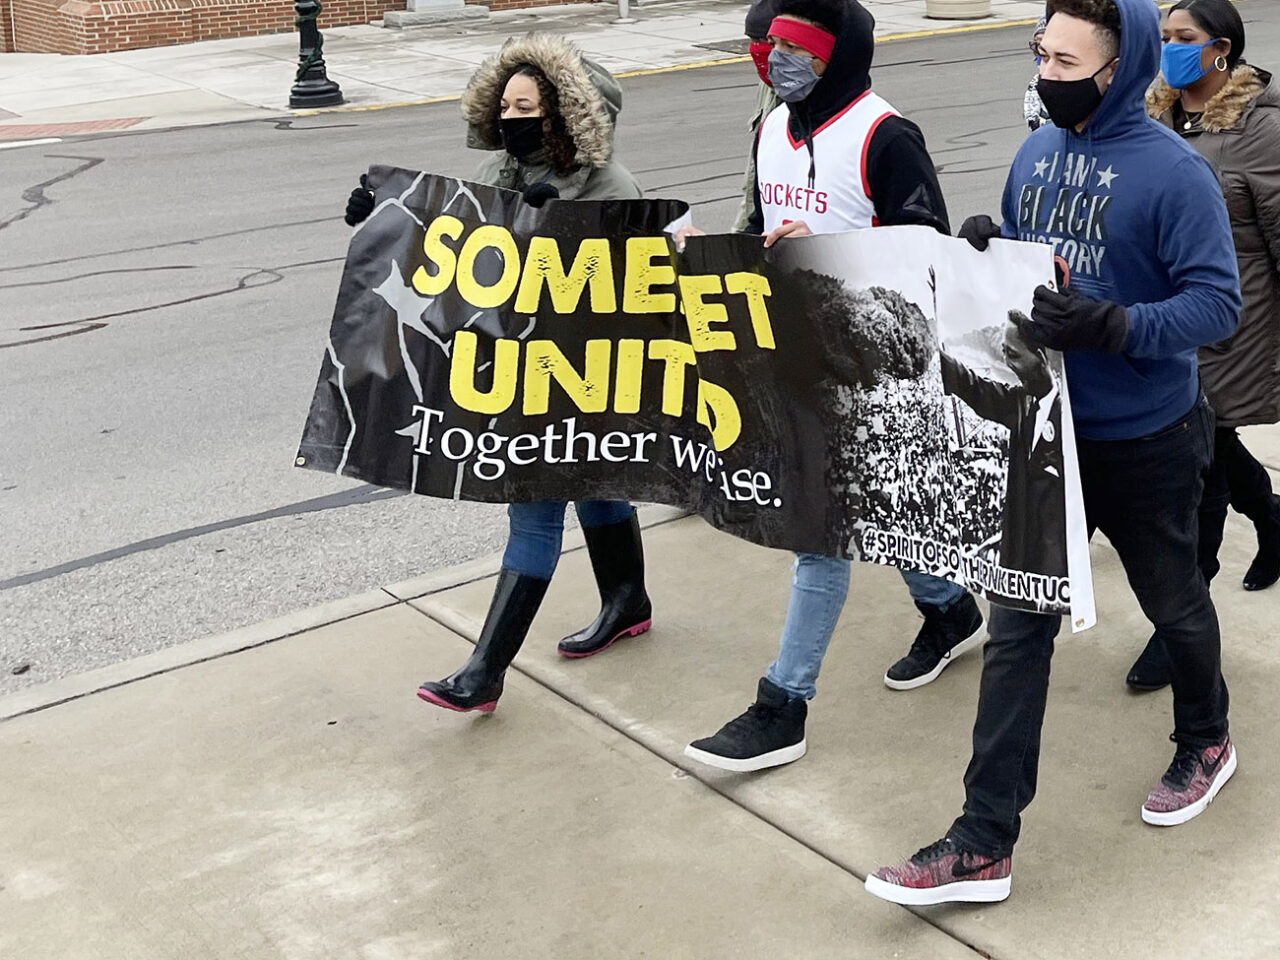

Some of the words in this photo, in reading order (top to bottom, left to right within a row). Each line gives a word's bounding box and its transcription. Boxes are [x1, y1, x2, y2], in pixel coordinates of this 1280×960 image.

[1047, 151, 1059, 182] I
[1057, 152, 1097, 189] AM
[1017, 184, 1111, 240] BLACK
[1020, 231, 1107, 277] TORY
[411, 405, 657, 481] Together
[669, 434, 716, 482] we
[717, 456, 782, 508] ise.
